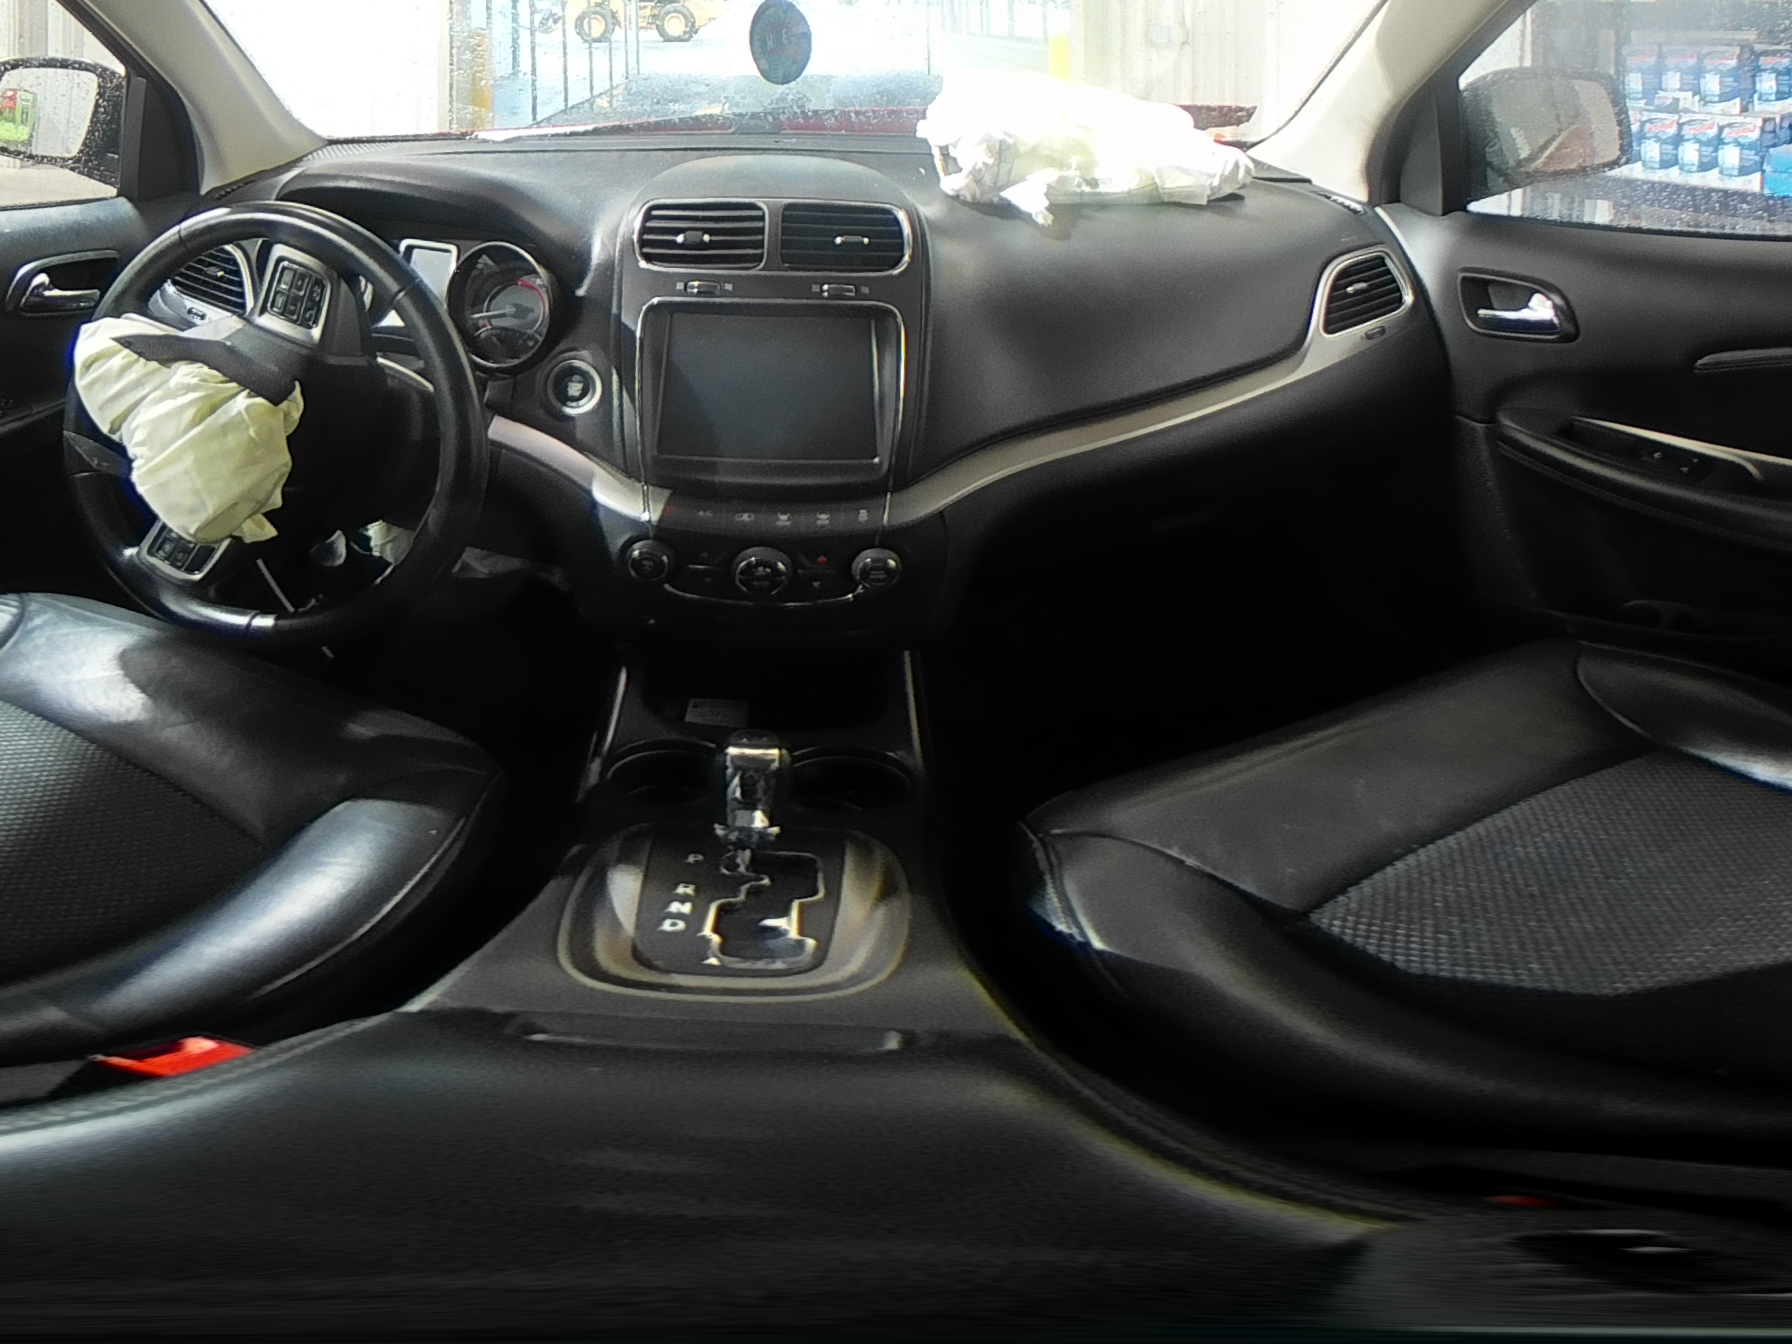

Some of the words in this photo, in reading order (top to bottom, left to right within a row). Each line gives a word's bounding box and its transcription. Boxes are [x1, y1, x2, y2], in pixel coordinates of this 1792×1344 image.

[685, 853, 704, 864] P
[673, 882, 697, 897] R
[664, 900, 694, 915] N
[656, 918, 687, 932] D
